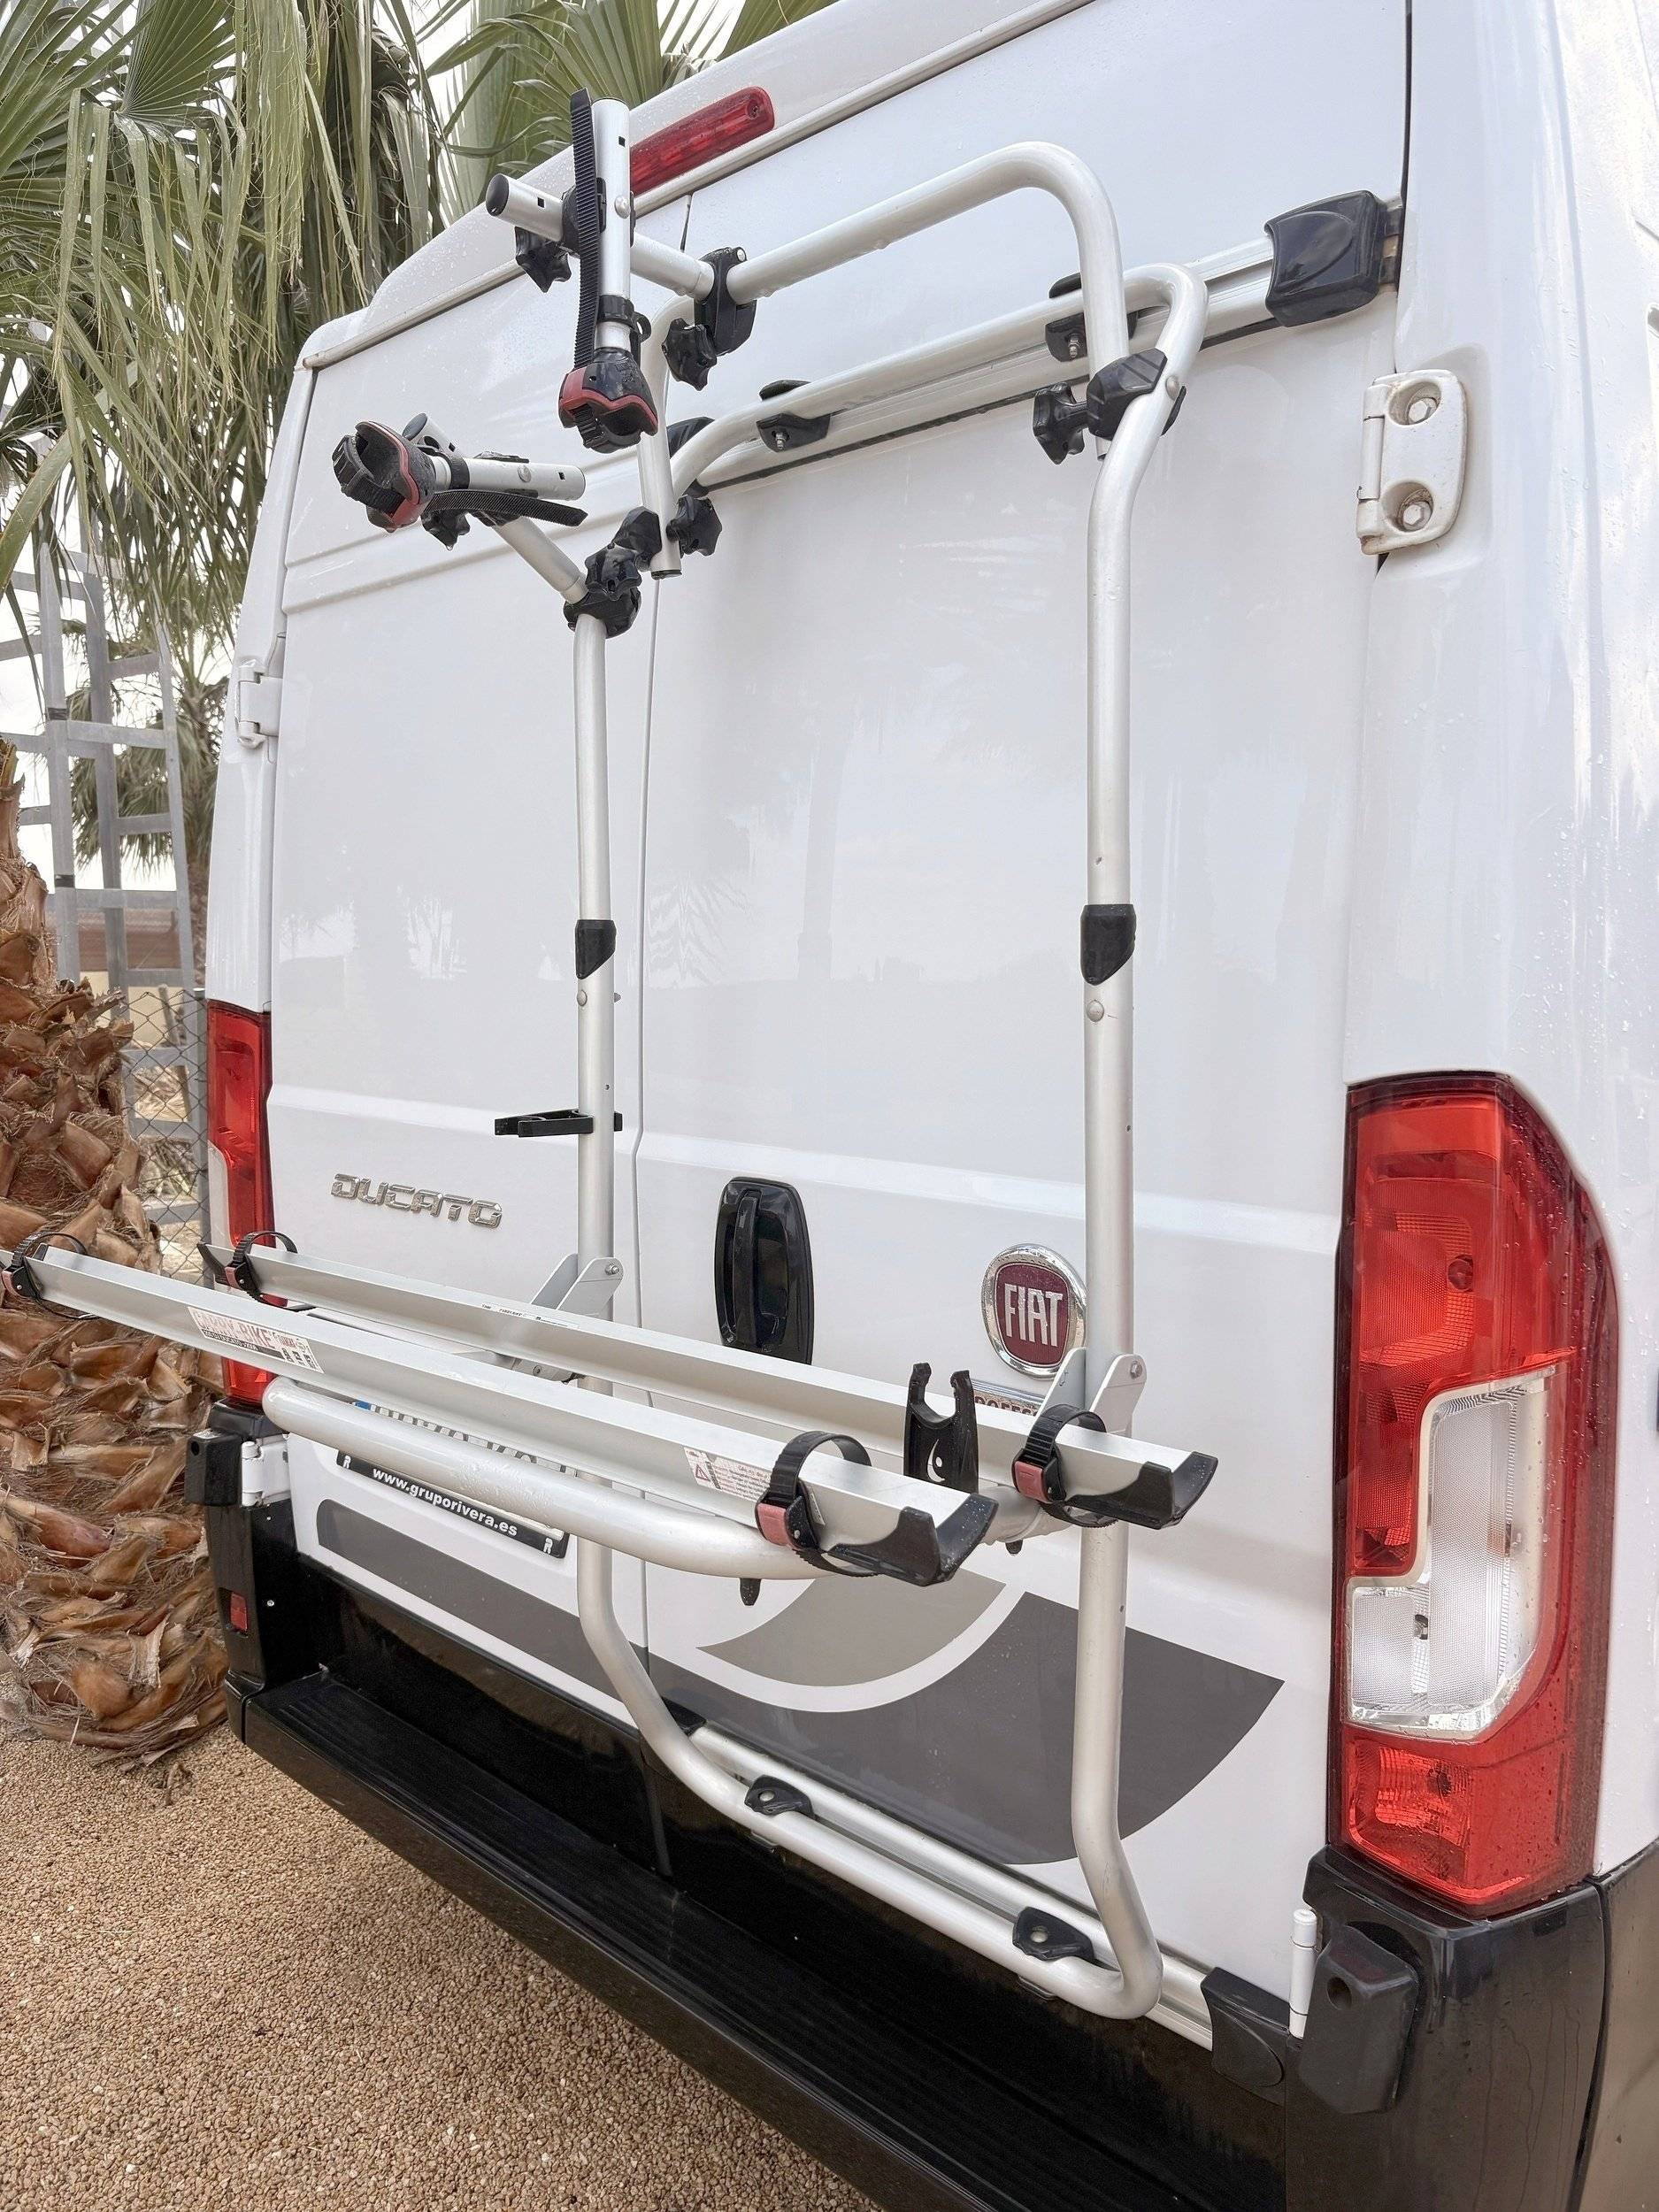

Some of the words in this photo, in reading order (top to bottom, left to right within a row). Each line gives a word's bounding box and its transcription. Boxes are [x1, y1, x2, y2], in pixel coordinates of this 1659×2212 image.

[331, 1173, 503, 1228] DUCATO
[1004, 1283, 1063, 1347] FIAT
[373, 1468, 518, 1537] www.gruporivera.es
